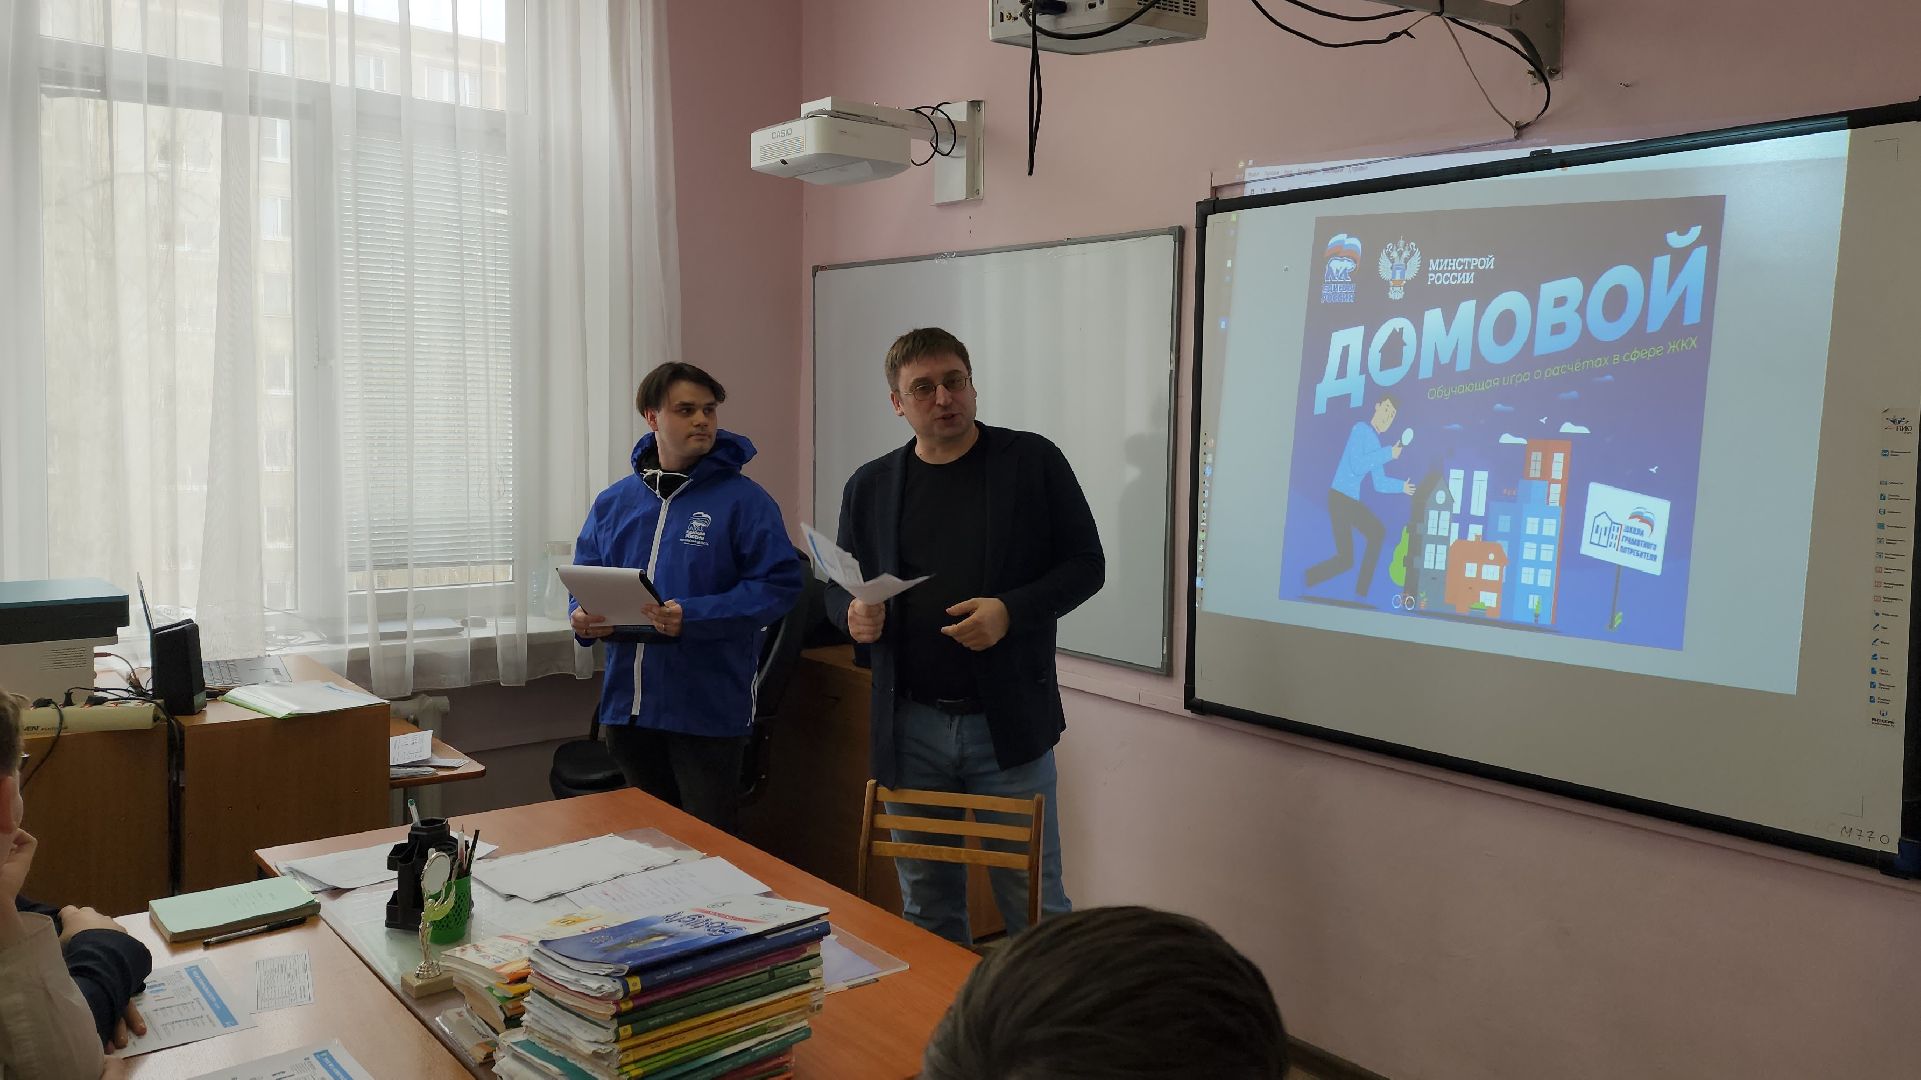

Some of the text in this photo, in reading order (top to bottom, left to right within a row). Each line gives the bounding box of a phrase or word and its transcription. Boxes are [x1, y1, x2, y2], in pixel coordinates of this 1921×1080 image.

[772, 128, 792, 139] CASIO
[1429, 255, 1495, 270] МИНСТРОЙ
[1428, 272, 1475, 285] РОССИИ
[1314, 225, 1708, 415] ДОМОВОЙ
[1428, 335, 1698, 400] Обучающая игра о расчётах в сфере ЖКХ
